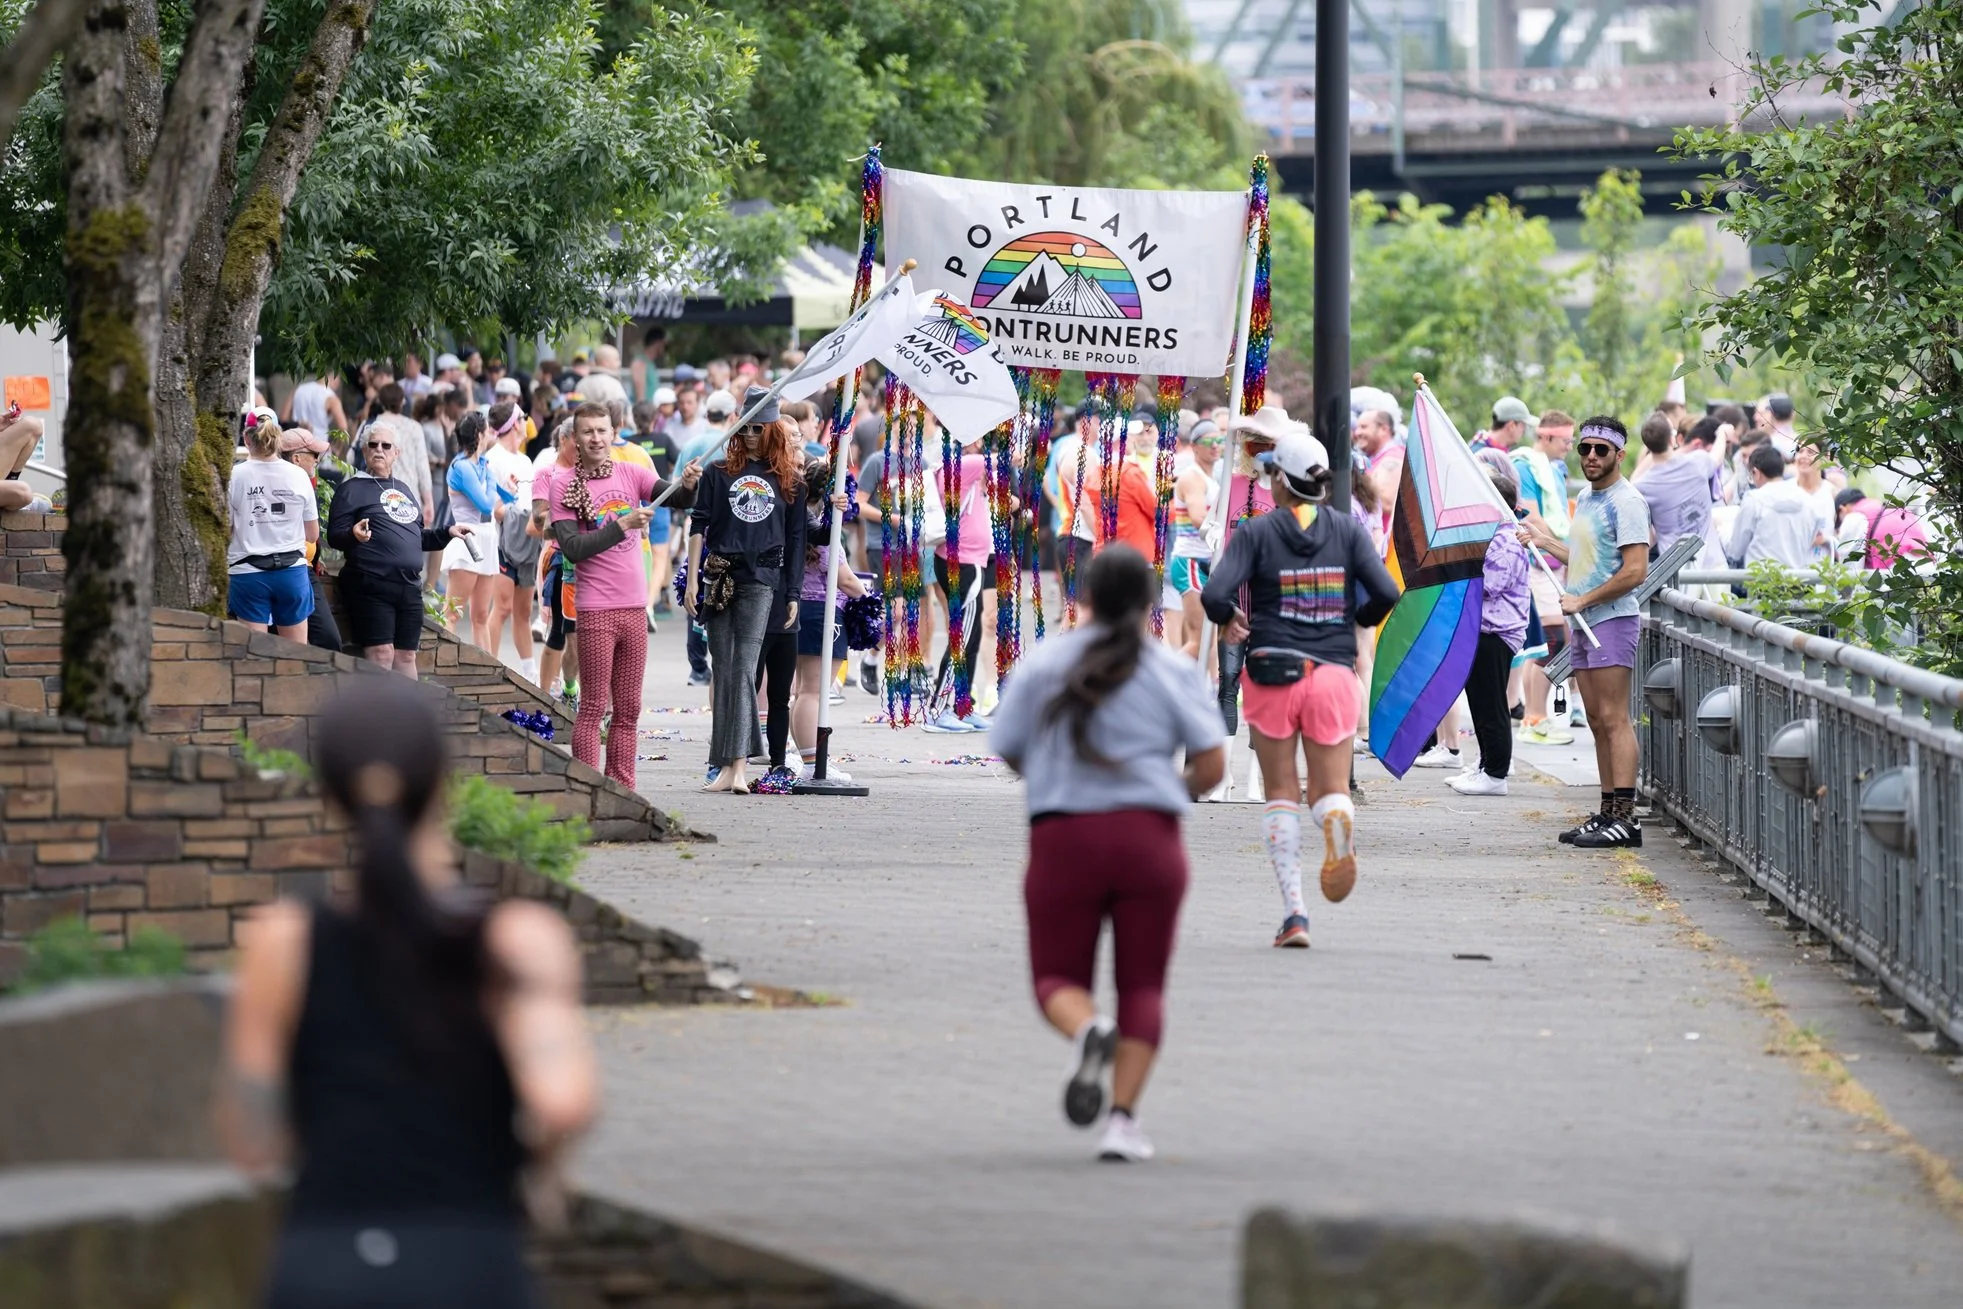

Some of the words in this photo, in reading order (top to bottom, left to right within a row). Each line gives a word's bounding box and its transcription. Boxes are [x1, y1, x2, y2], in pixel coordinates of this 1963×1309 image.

[944, 195, 1172, 292] PORTLAND
[976, 315, 1178, 350] ONTRUNNERS
[1011, 345, 1057, 360] WALK.
[1063, 351, 1080, 361] BE
[1086, 352, 1140, 365] PROUD.
[246, 486, 265, 496] JAX
[594, 492, 635, 508] ORTLAND
